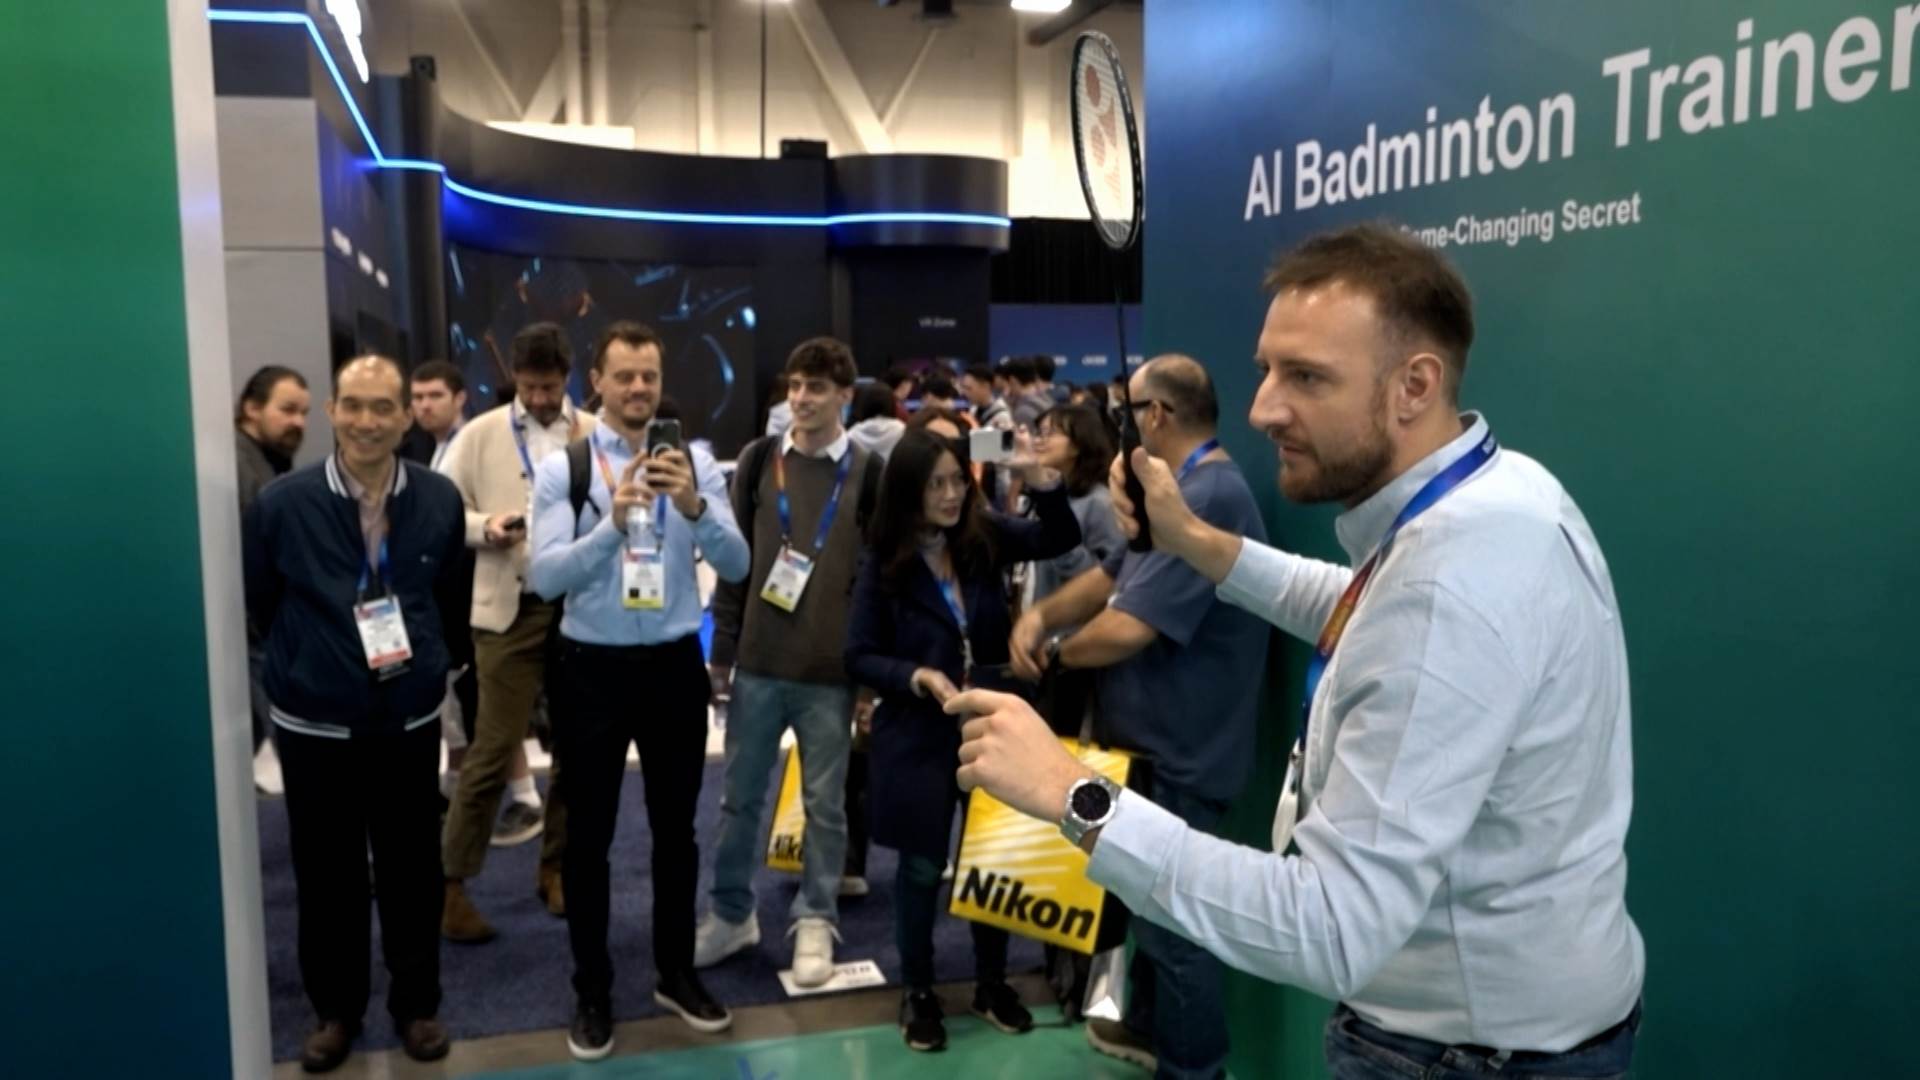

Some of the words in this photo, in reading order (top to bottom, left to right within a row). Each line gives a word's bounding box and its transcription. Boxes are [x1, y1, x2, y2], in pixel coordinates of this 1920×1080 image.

[1244, 149, 1282, 221] AI
[1295, 92, 1576, 211] Badminton
[1602, 1, 1920, 148] Trainer
[1561, 192, 1641, 231] Secret
[959, 866, 1095, 939] Nikon
